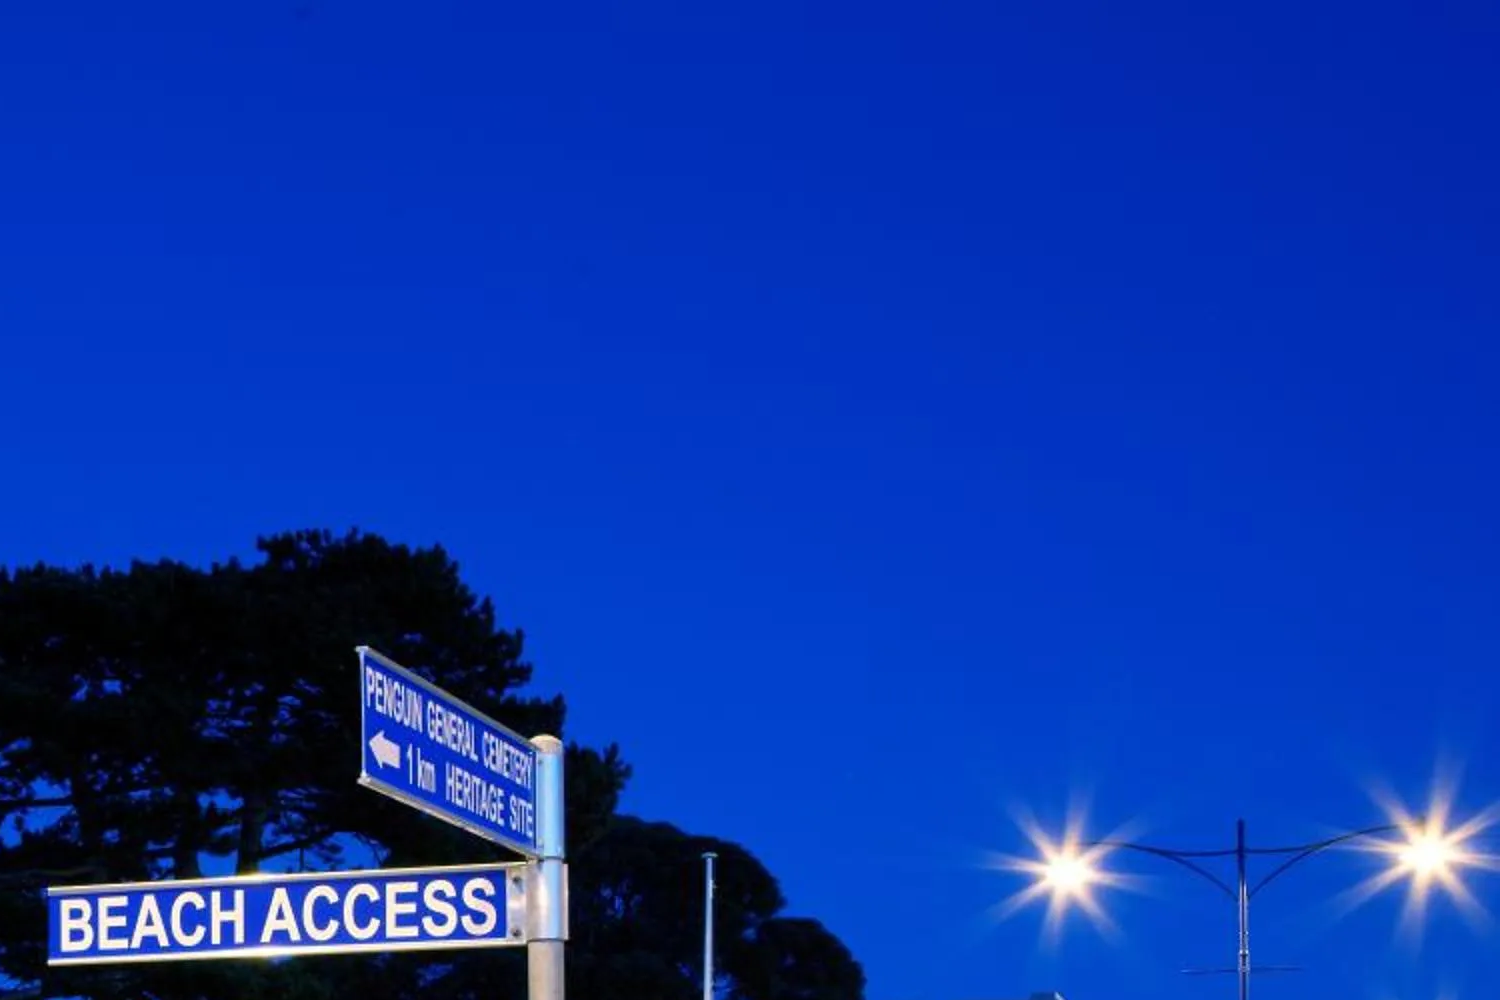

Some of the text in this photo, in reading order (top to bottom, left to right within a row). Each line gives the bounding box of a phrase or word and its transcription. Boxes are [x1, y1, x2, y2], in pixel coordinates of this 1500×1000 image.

[365, 665, 533, 789] PENGUIN GENERAL CEMETERY
[406, 743, 534, 838] 1 km HERITAGE SITE
[59, 876, 498, 953] BEACH ACCESS
